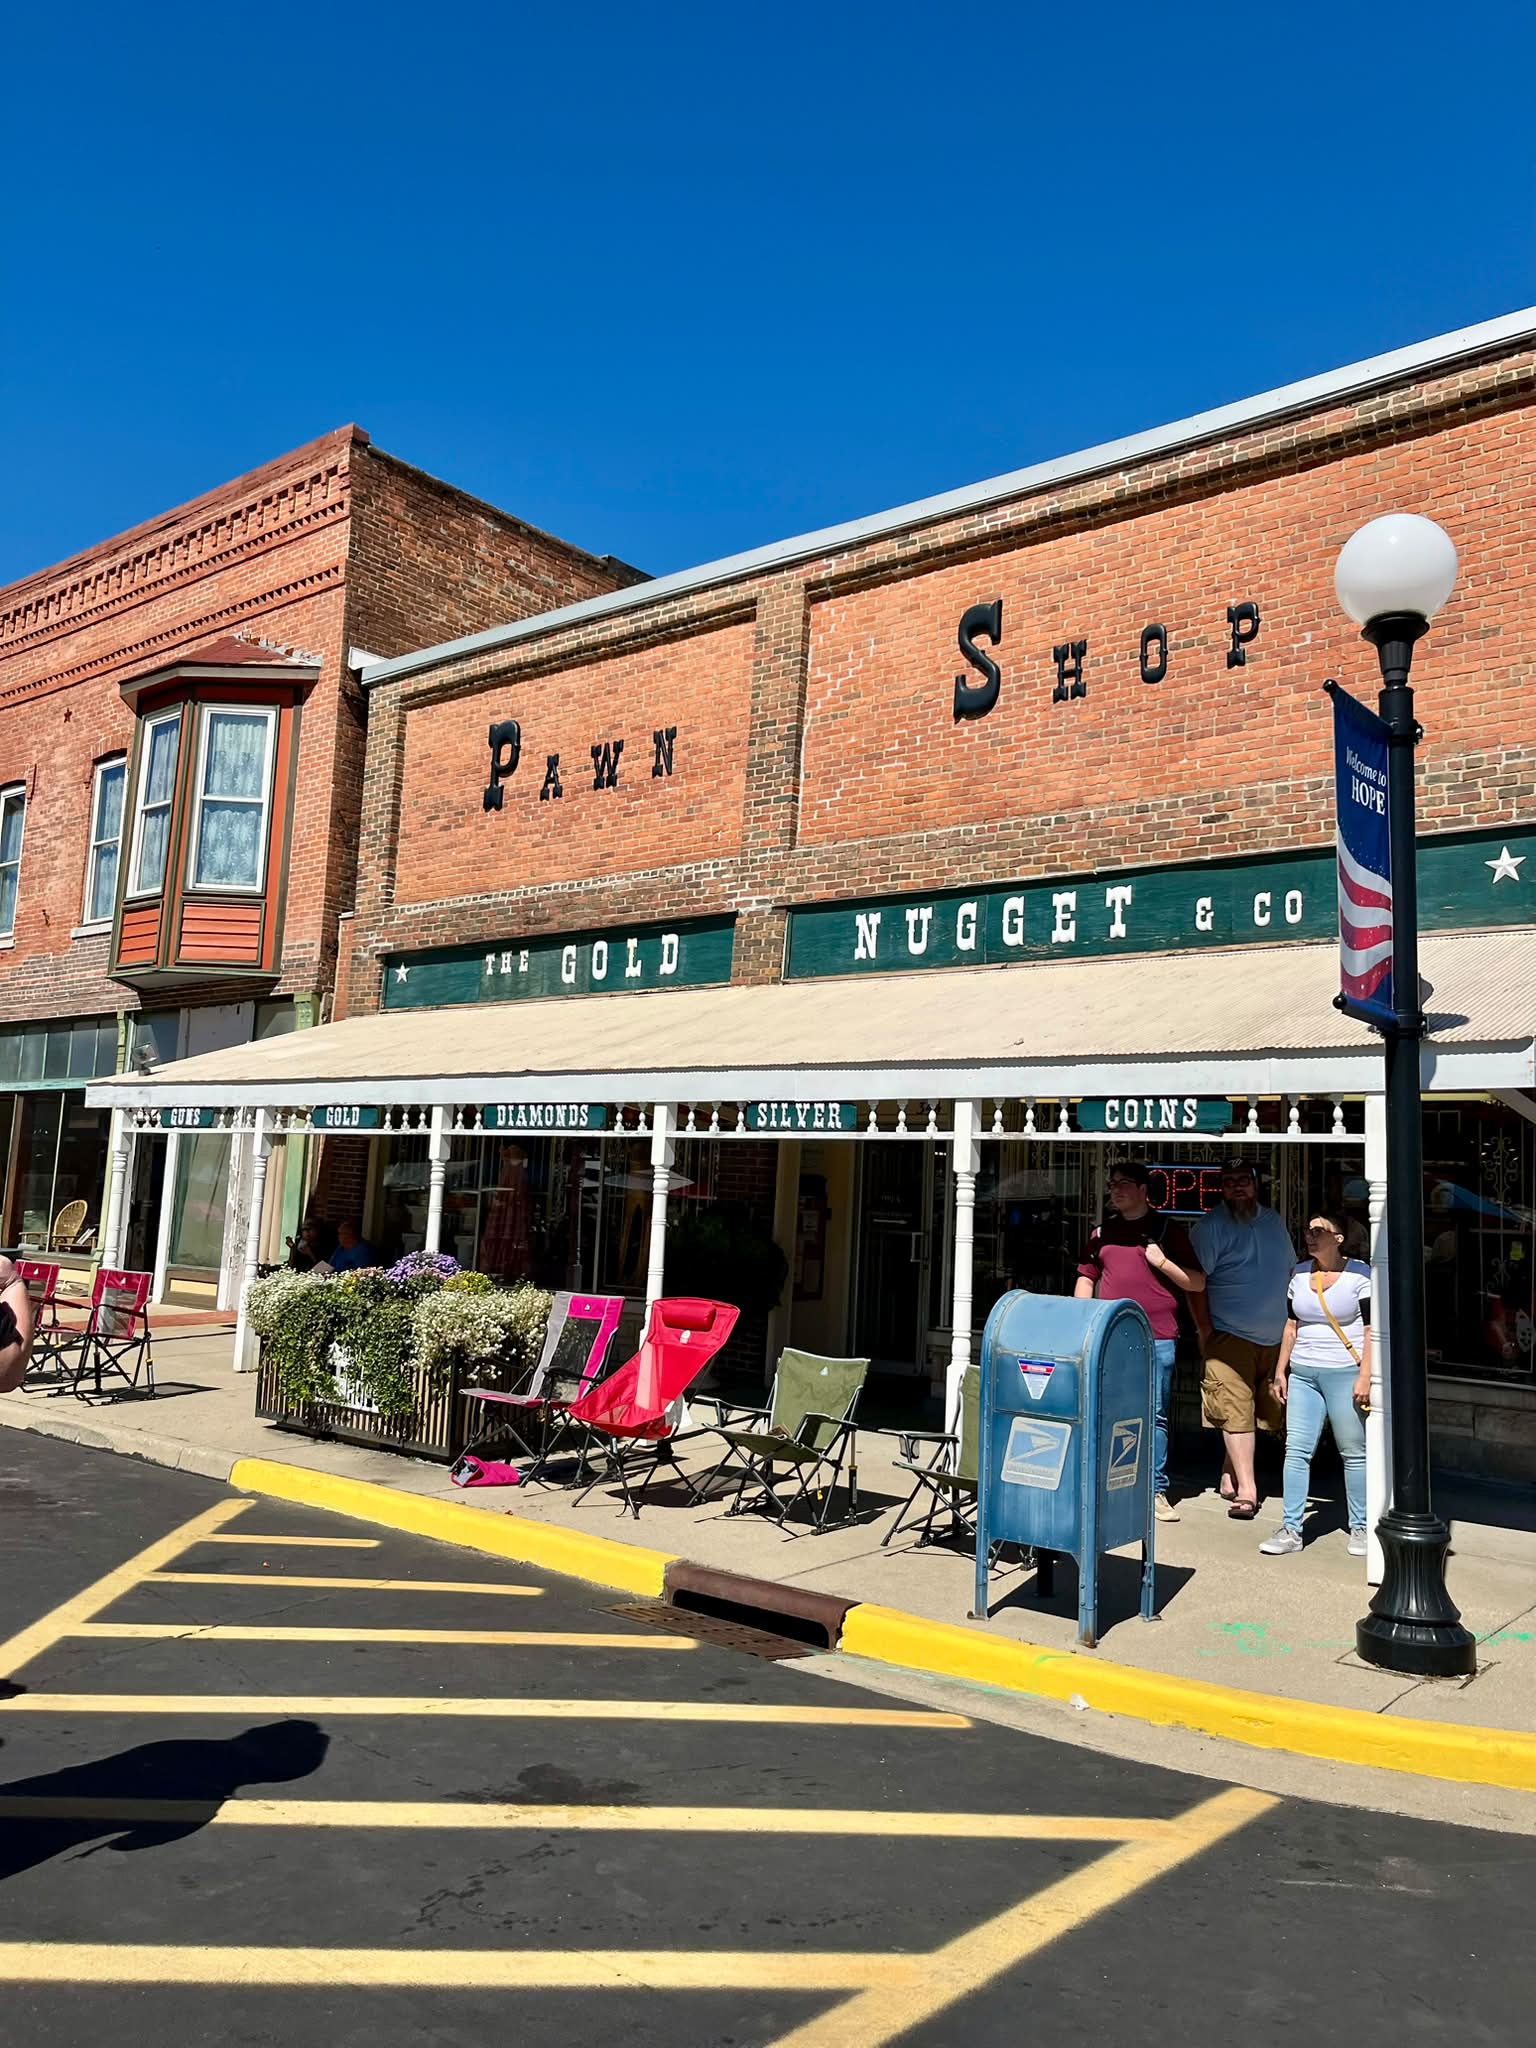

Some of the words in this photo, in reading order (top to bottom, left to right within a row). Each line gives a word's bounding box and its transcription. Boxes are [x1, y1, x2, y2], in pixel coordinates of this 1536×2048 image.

[483, 720, 677, 812] PAWN
[953, 599, 1261, 725] SHOP
[1346, 746, 1378, 782] Welcome
[1377, 770, 1387, 787] to
[1351, 775, 1386, 816] HOPE
[485, 949, 530, 976] THE
[561, 933, 680, 984] GOLD
[854, 884, 1133, 961] NUGGET
[1195, 896, 1214, 931] &
[1254, 889, 1304, 926] CO
[170, 1107, 201, 1126] GUNS
[326, 1106, 360, 1127] GOLD
[496, 1103, 590, 1128] DIAMONDS
[756, 1102, 842, 1129] SILVER
[1105, 1098, 1198, 1129] COINS
[1146, 1168, 1223, 1211] OPE
